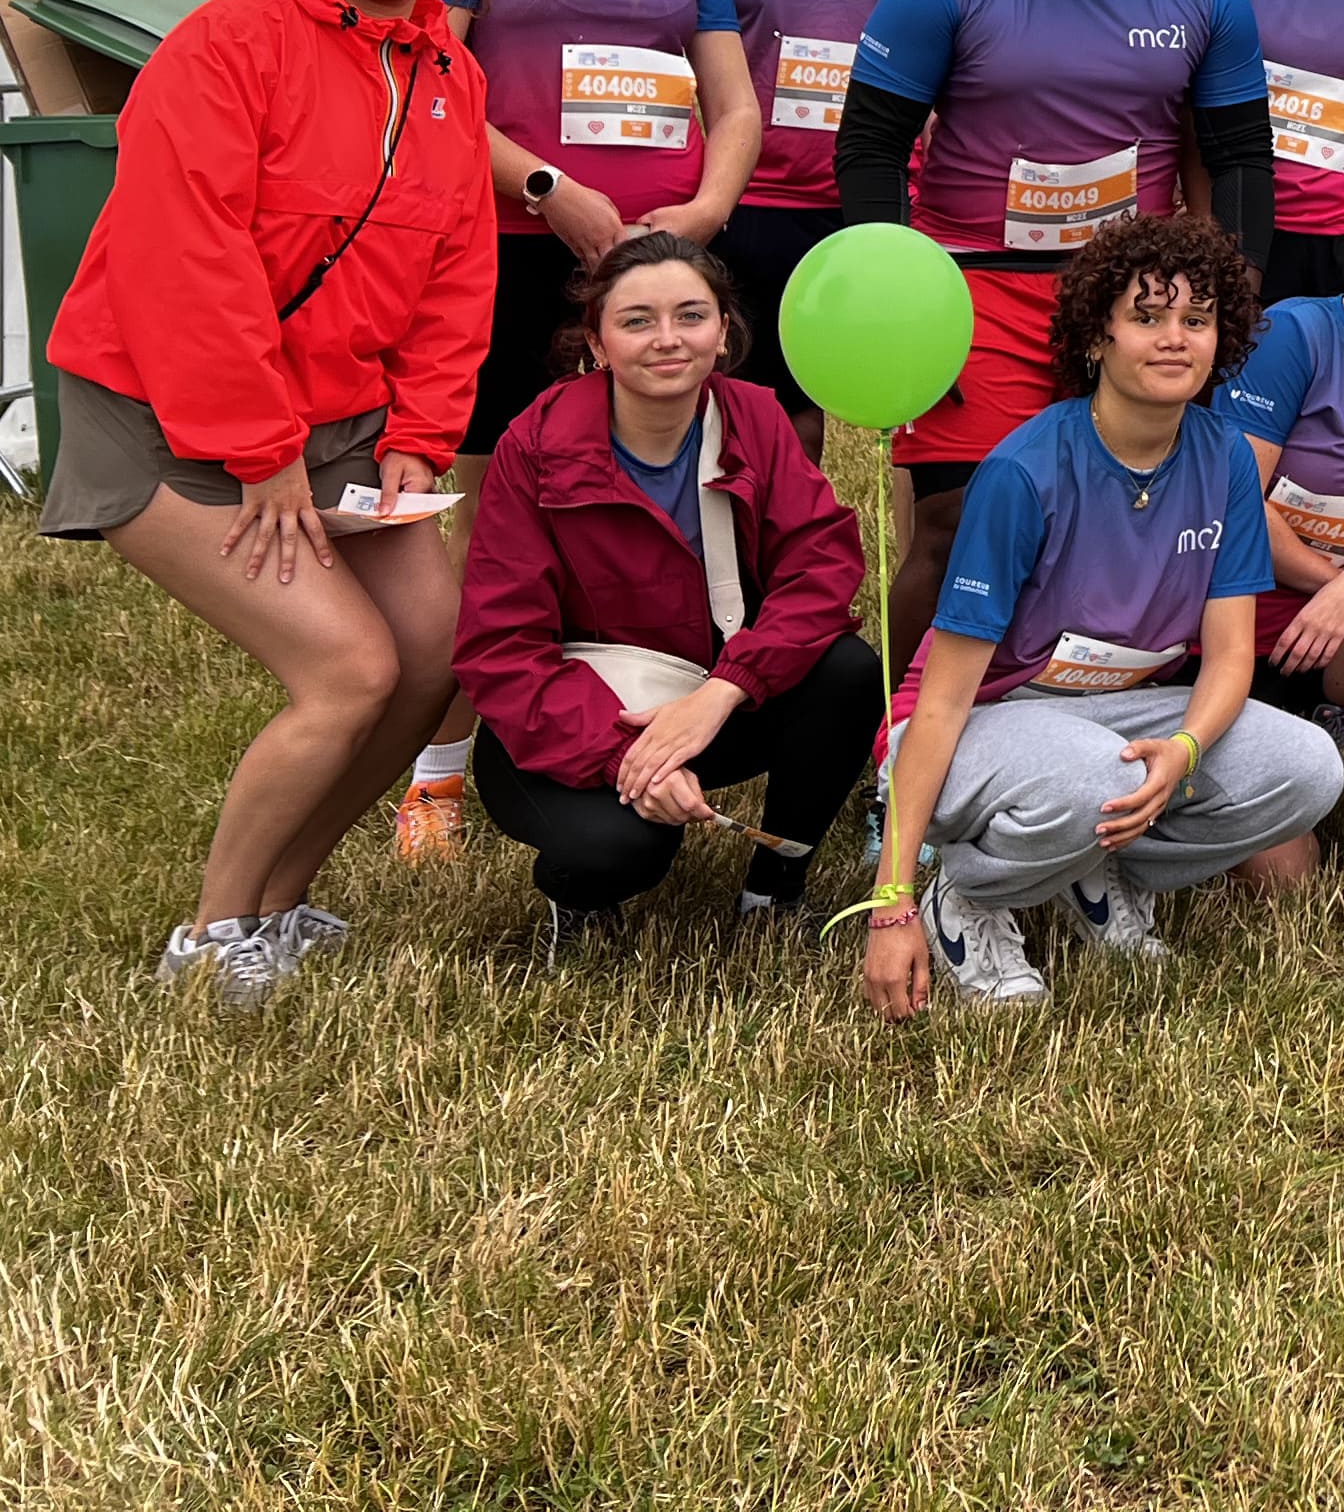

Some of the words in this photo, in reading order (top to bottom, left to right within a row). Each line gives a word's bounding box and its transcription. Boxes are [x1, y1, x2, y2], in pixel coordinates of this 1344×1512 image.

[1129, 25, 1186, 49] mc2i
[578, 75, 657, 98] 404005
[1020, 187, 1098, 209] 404049
[1177, 520, 1222, 554] mc2
[1053, 667, 1133, 686] 404002
